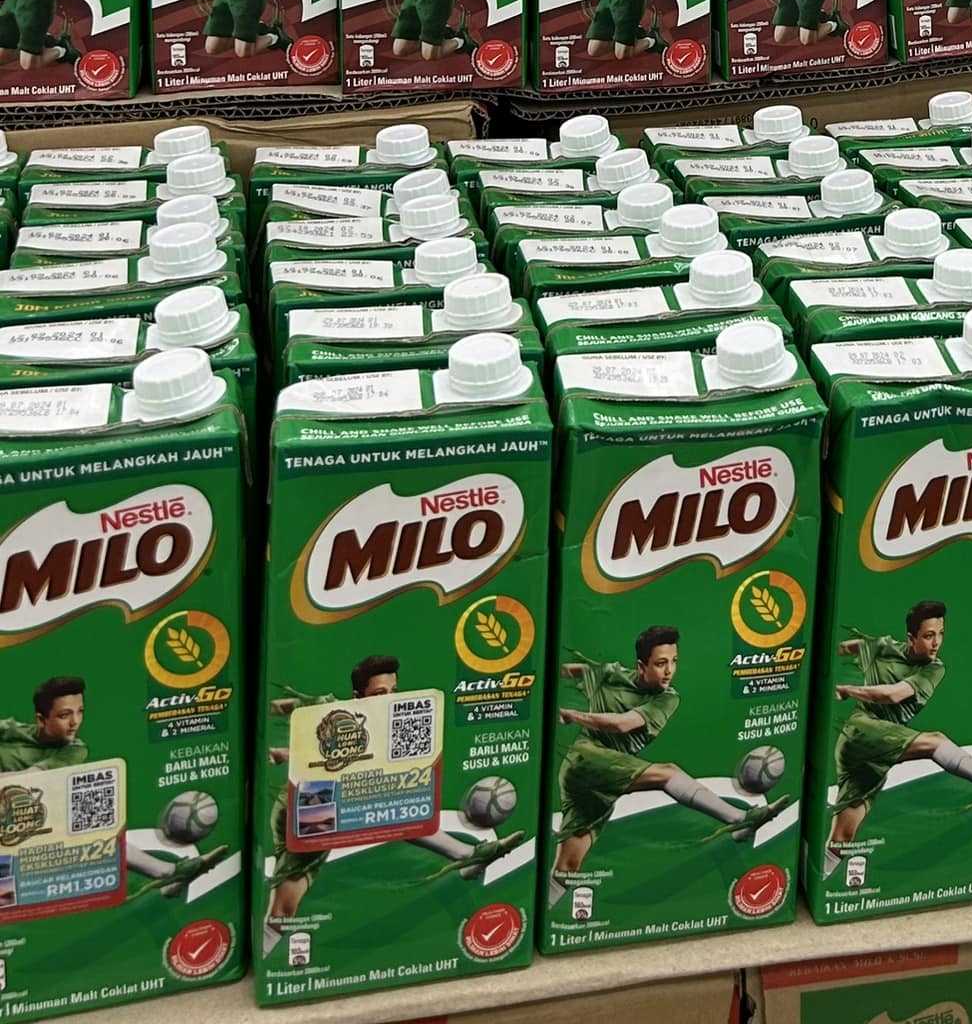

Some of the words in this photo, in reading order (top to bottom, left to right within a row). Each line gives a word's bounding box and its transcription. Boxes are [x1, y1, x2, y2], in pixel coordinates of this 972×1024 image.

[227, 74, 246, 83] Malt
[272, 71, 289, 80] UHT
[284, 455, 346, 470] TENAGA
[350, 450, 402, 465] UNTUK
[405, 443, 497, 461] MELANGKAH
[611, 481, 778, 561] MILO
[323, 508, 506, 592] MILO
[1, 523, 195, 615] MILO
[393, 700, 432, 712] IMBAS
[481, 703, 513, 712] VITAMIN
[474, 728, 530, 744] KEBAIKAN
[469, 743, 499, 757] BARLI
[462, 758, 490, 771] SUSU
[492, 757, 500, 767] &
[502, 752, 529, 765] KOKO
